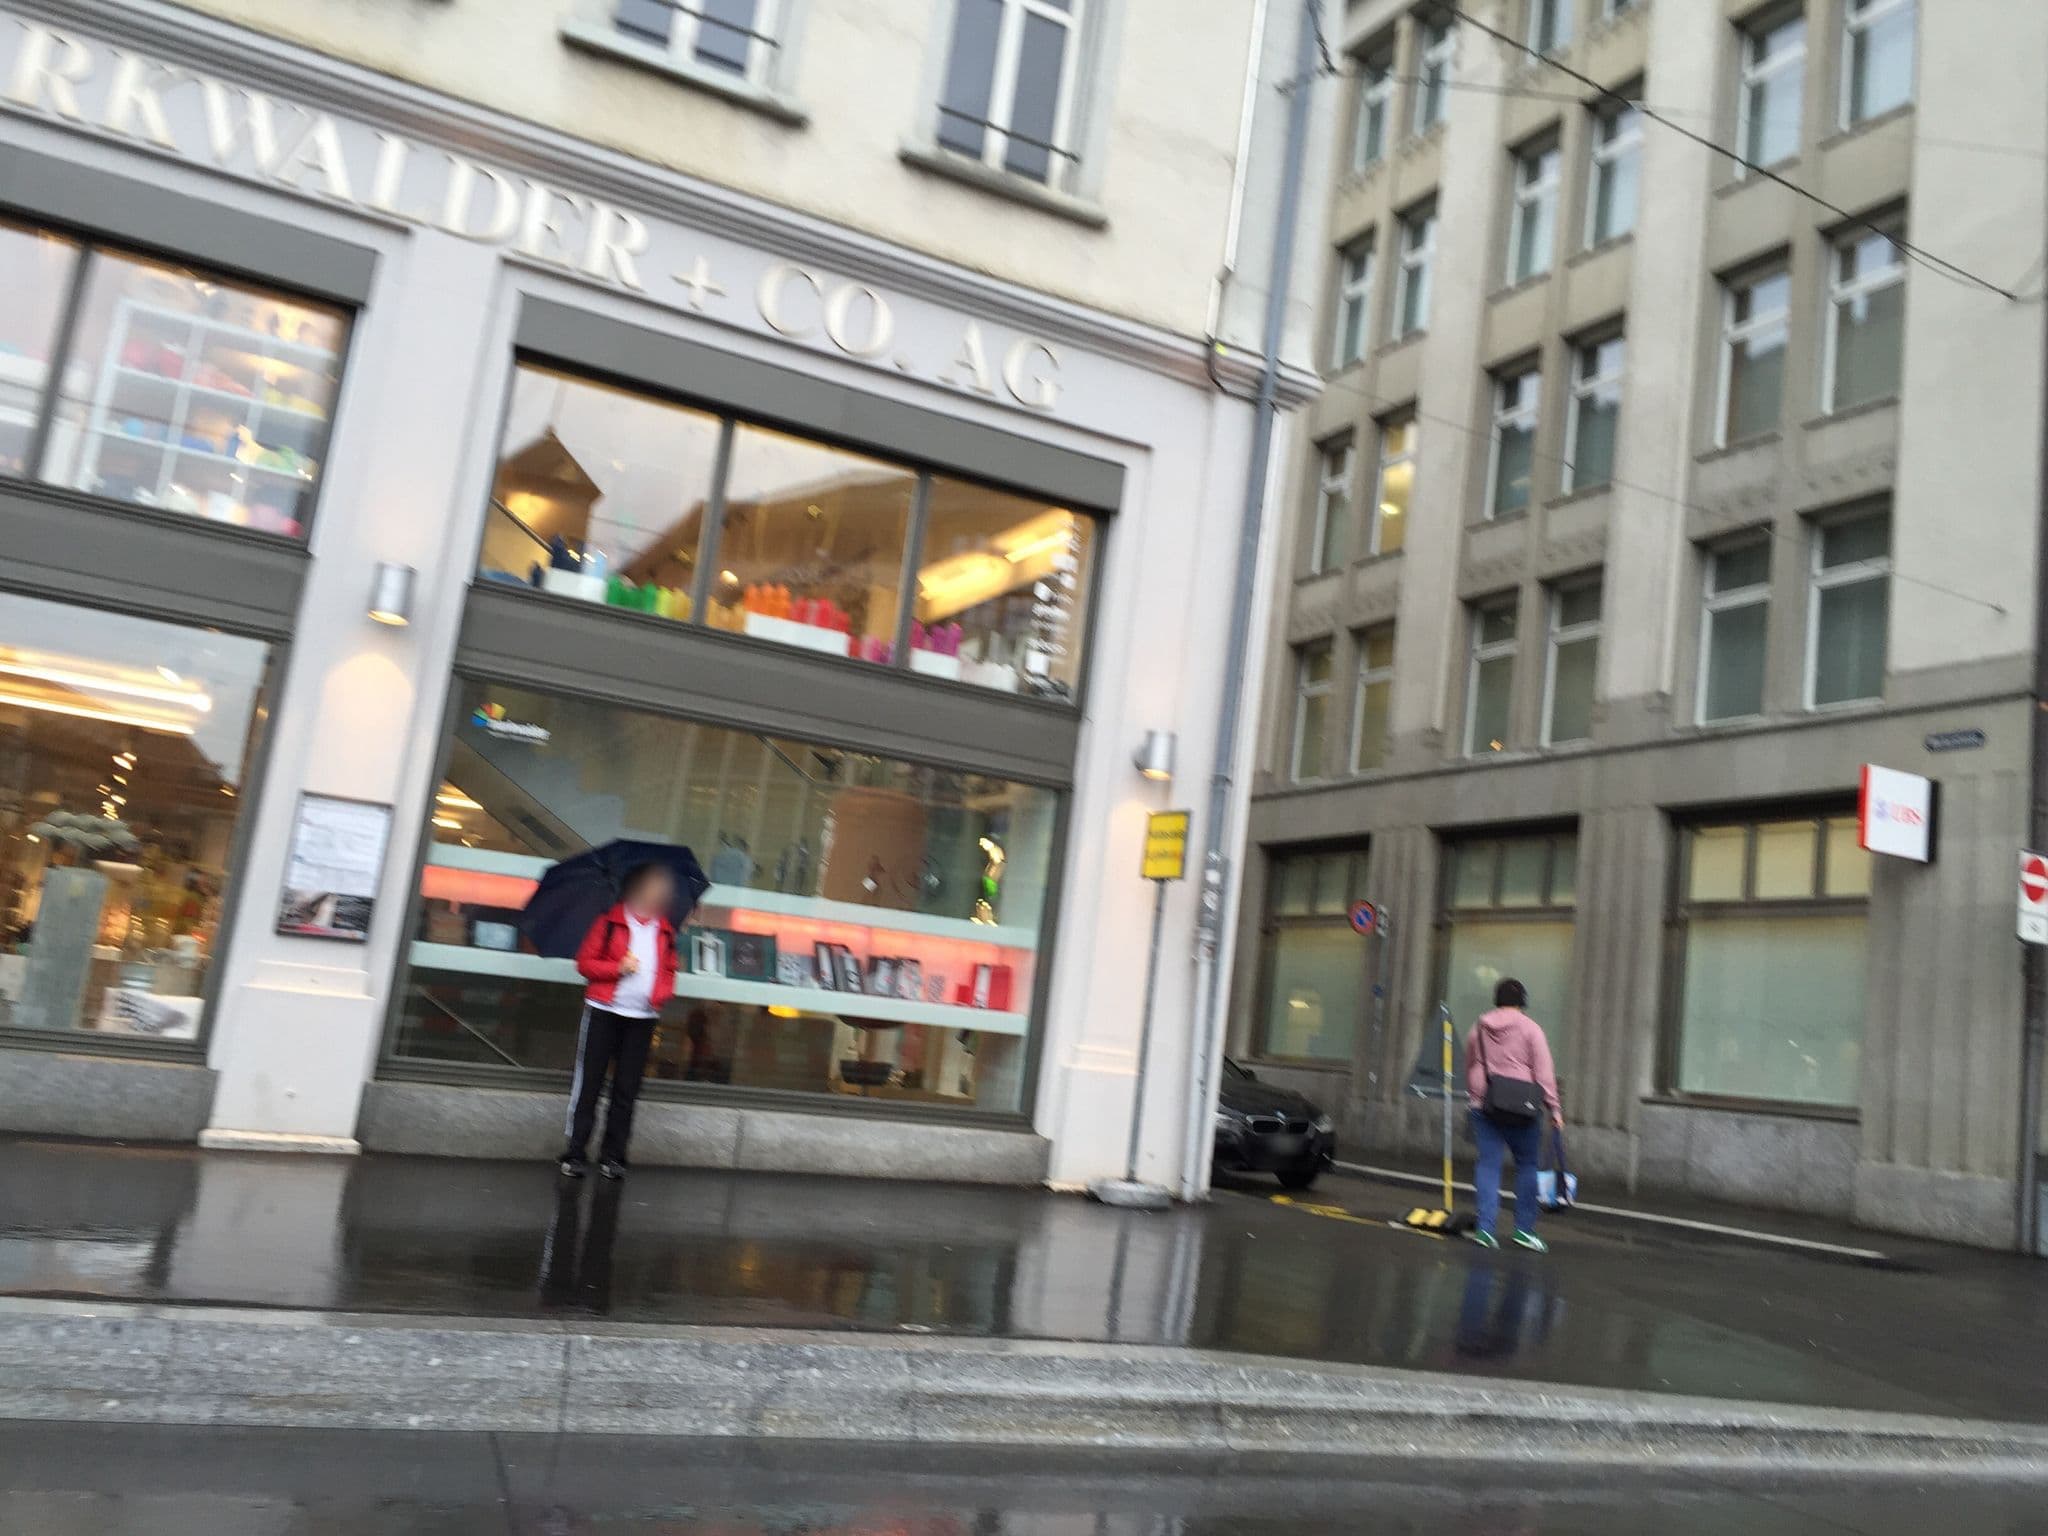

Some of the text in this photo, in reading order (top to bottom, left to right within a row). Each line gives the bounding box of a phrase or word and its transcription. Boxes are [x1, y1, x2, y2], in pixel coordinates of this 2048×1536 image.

[6, 20, 1063, 411] RKWALDER + CO. AG
